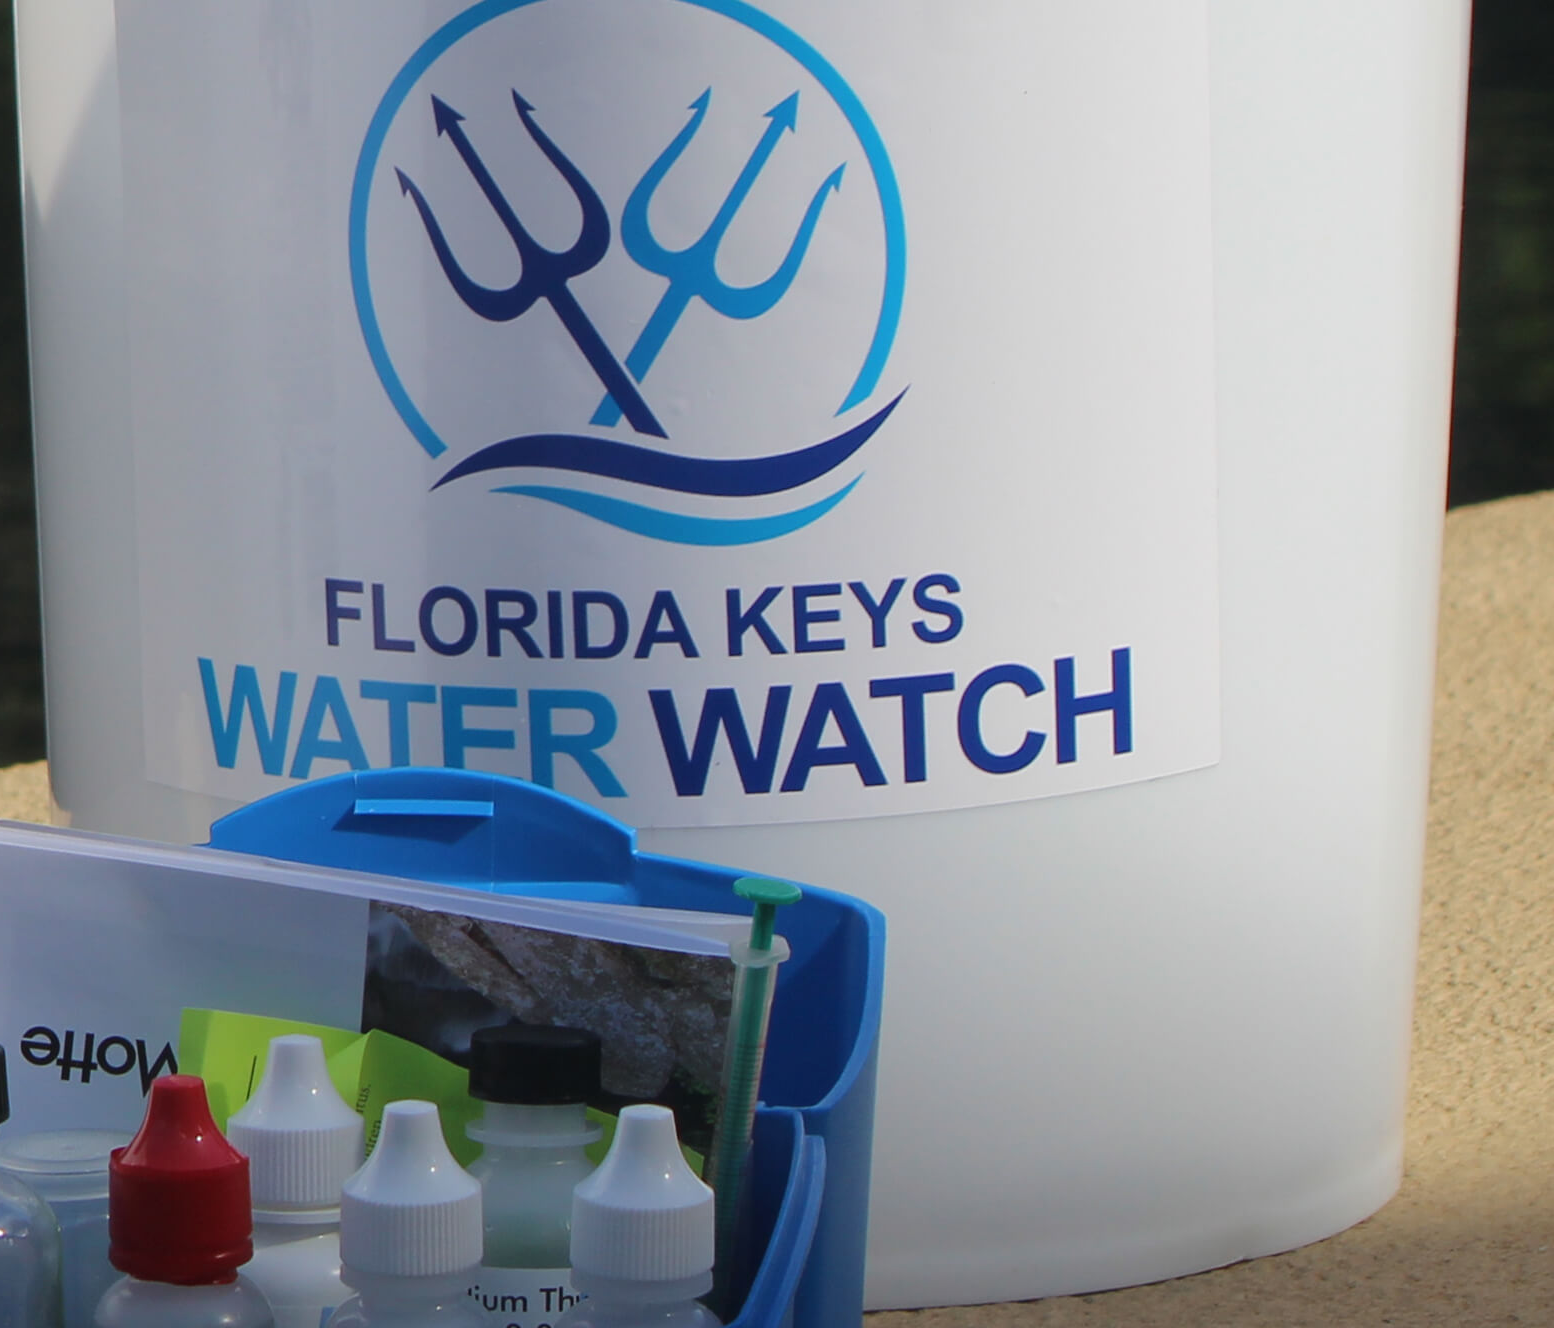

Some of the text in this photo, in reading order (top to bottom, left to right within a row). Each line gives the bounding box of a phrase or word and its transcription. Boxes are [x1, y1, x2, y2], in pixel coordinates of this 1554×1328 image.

[325, 573, 965, 659] FLORIDA KEYS
[197, 647, 1134, 798] WATER WATCH
